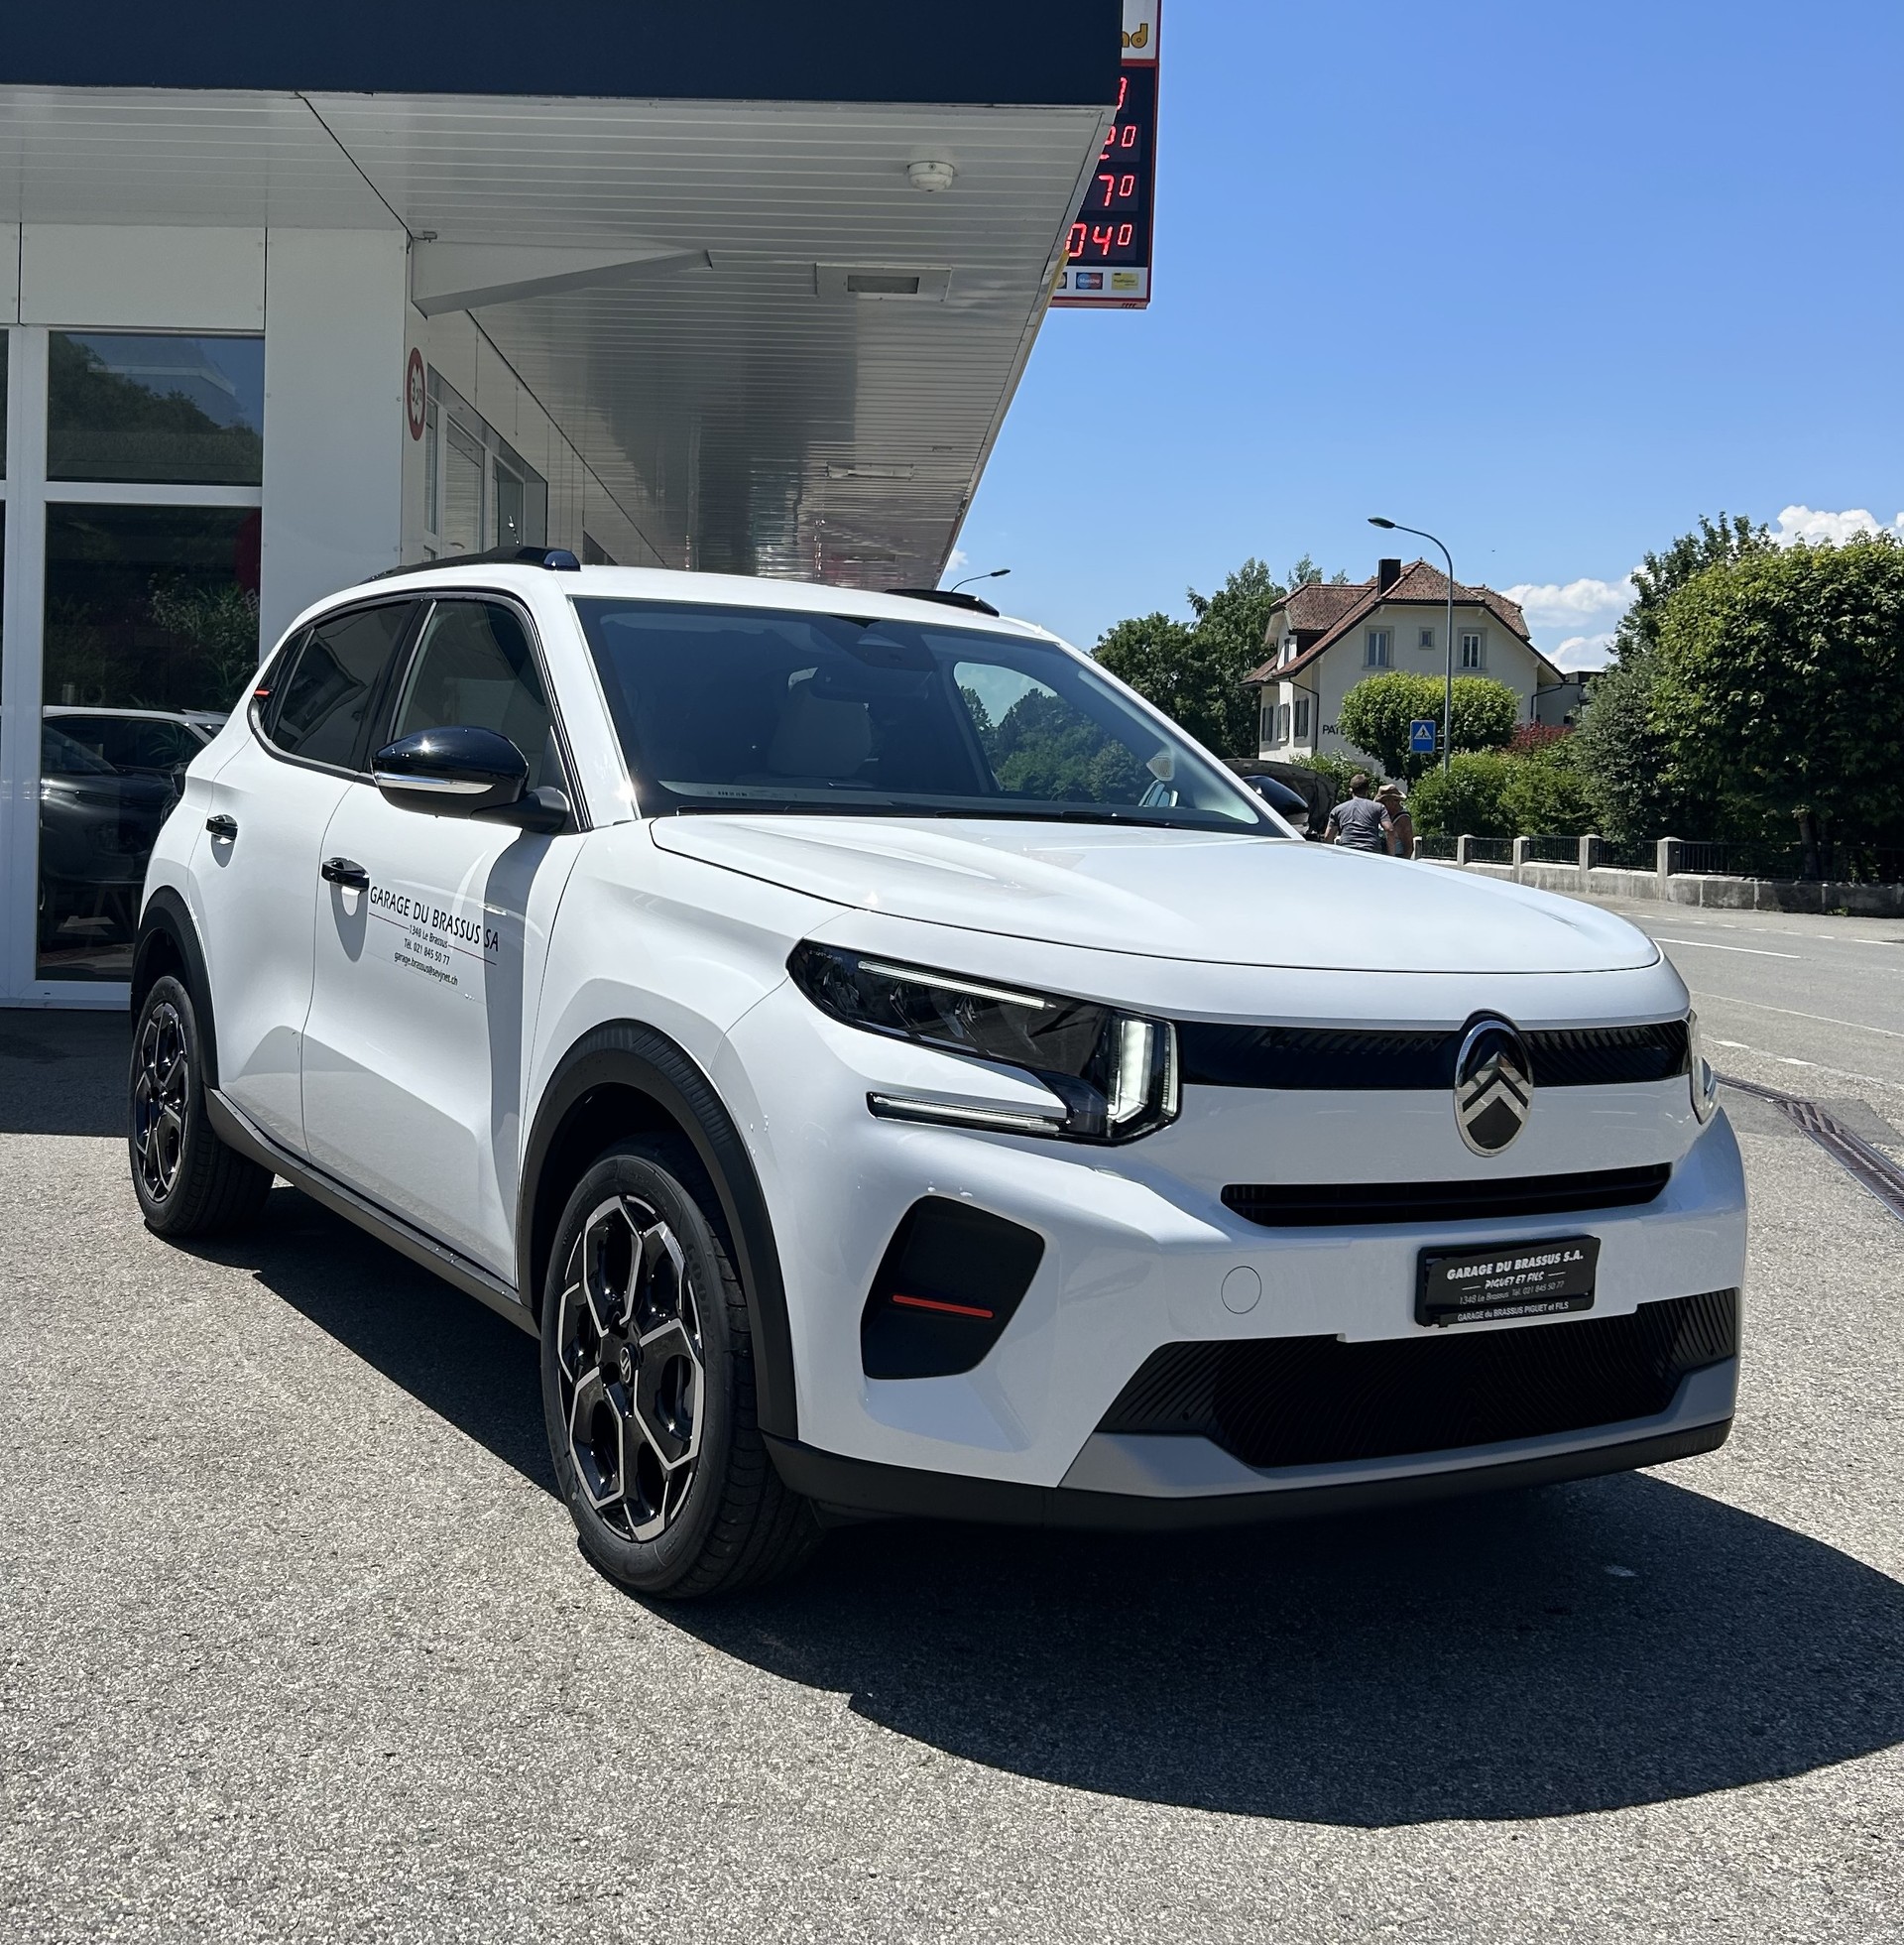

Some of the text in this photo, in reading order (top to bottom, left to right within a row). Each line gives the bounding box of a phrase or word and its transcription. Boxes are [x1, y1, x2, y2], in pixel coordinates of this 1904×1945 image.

[370, 886, 499, 952] GARAGE DU BRASSUS SA
[409, 924, 448, 949] 1348 Le Brassus
[414, 941, 422, 954] 021
[423, 946, 434, 959] 845
[434, 950, 442, 963] 50
[442, 954, 450, 966] 77
[1446, 1249, 1584, 1280] GARAGE DU BRASSUS S.A.
[1459, 1294, 1477, 1305] 1348
[1478, 1292, 1486, 1302] Le
[1486, 1291, 1510, 1301] Brassus
[1522, 1286, 1534, 1295] 021
[1547, 1281, 1556, 1291] 50
[1556, 1279, 1565, 1289] 77
[1485, 1271, 1545, 1290] PIGUET ET FILS
[1457, 1301, 1570, 1322] GARAGE du BRASSUS PIGUET et FILS
